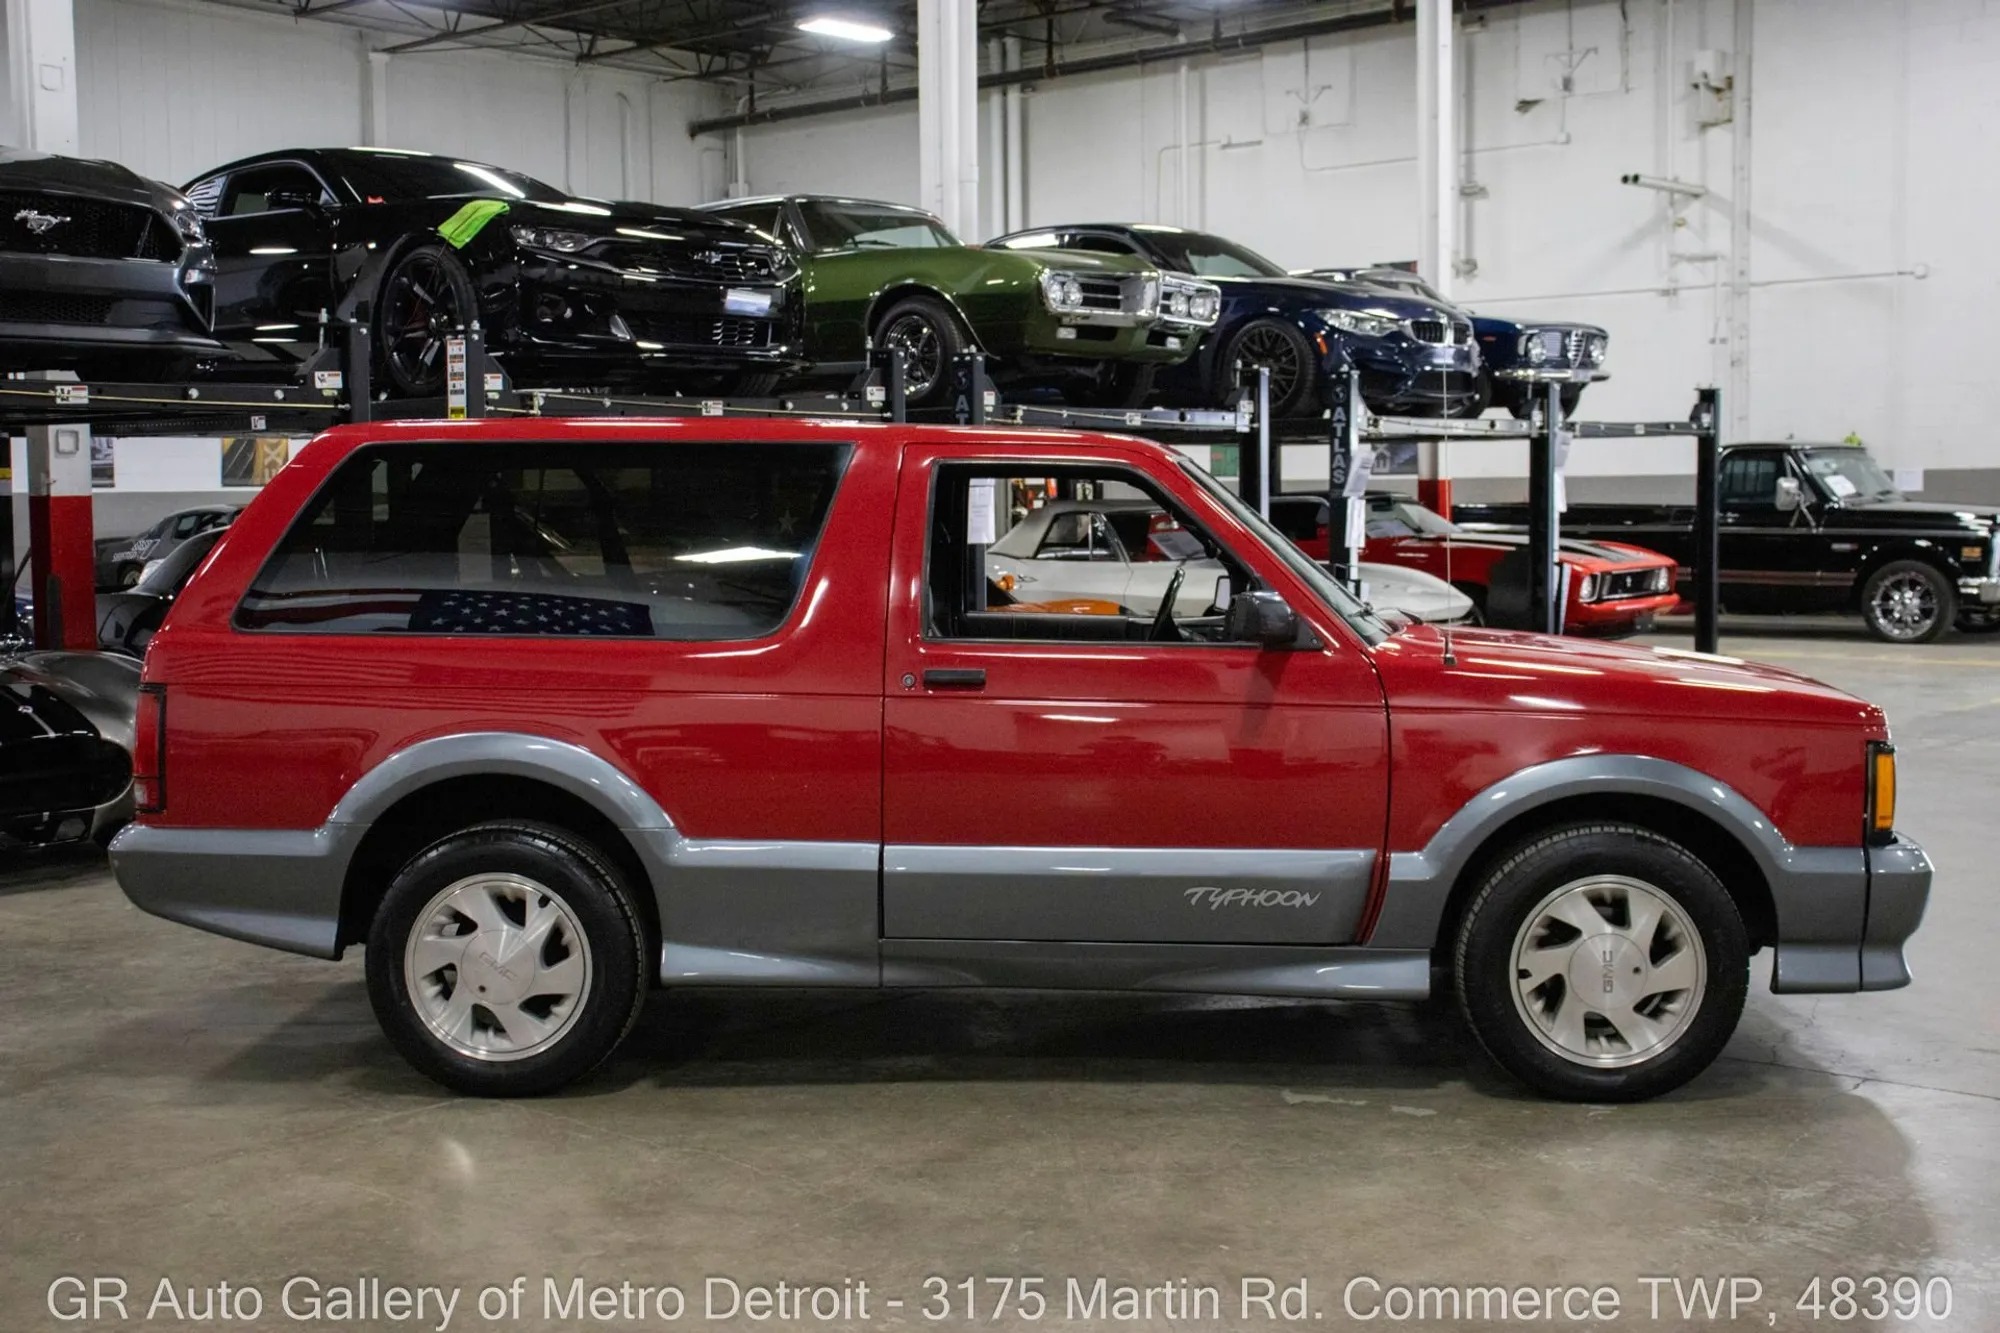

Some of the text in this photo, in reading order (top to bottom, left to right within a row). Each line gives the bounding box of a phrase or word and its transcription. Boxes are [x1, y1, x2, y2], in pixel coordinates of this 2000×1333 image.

[1332, 406, 1347, 484] ATLAS
[1183, 886, 1322, 911] TYPHOON
[479, 951, 518, 984] GMC
[1602, 950, 1613, 993] GMC
